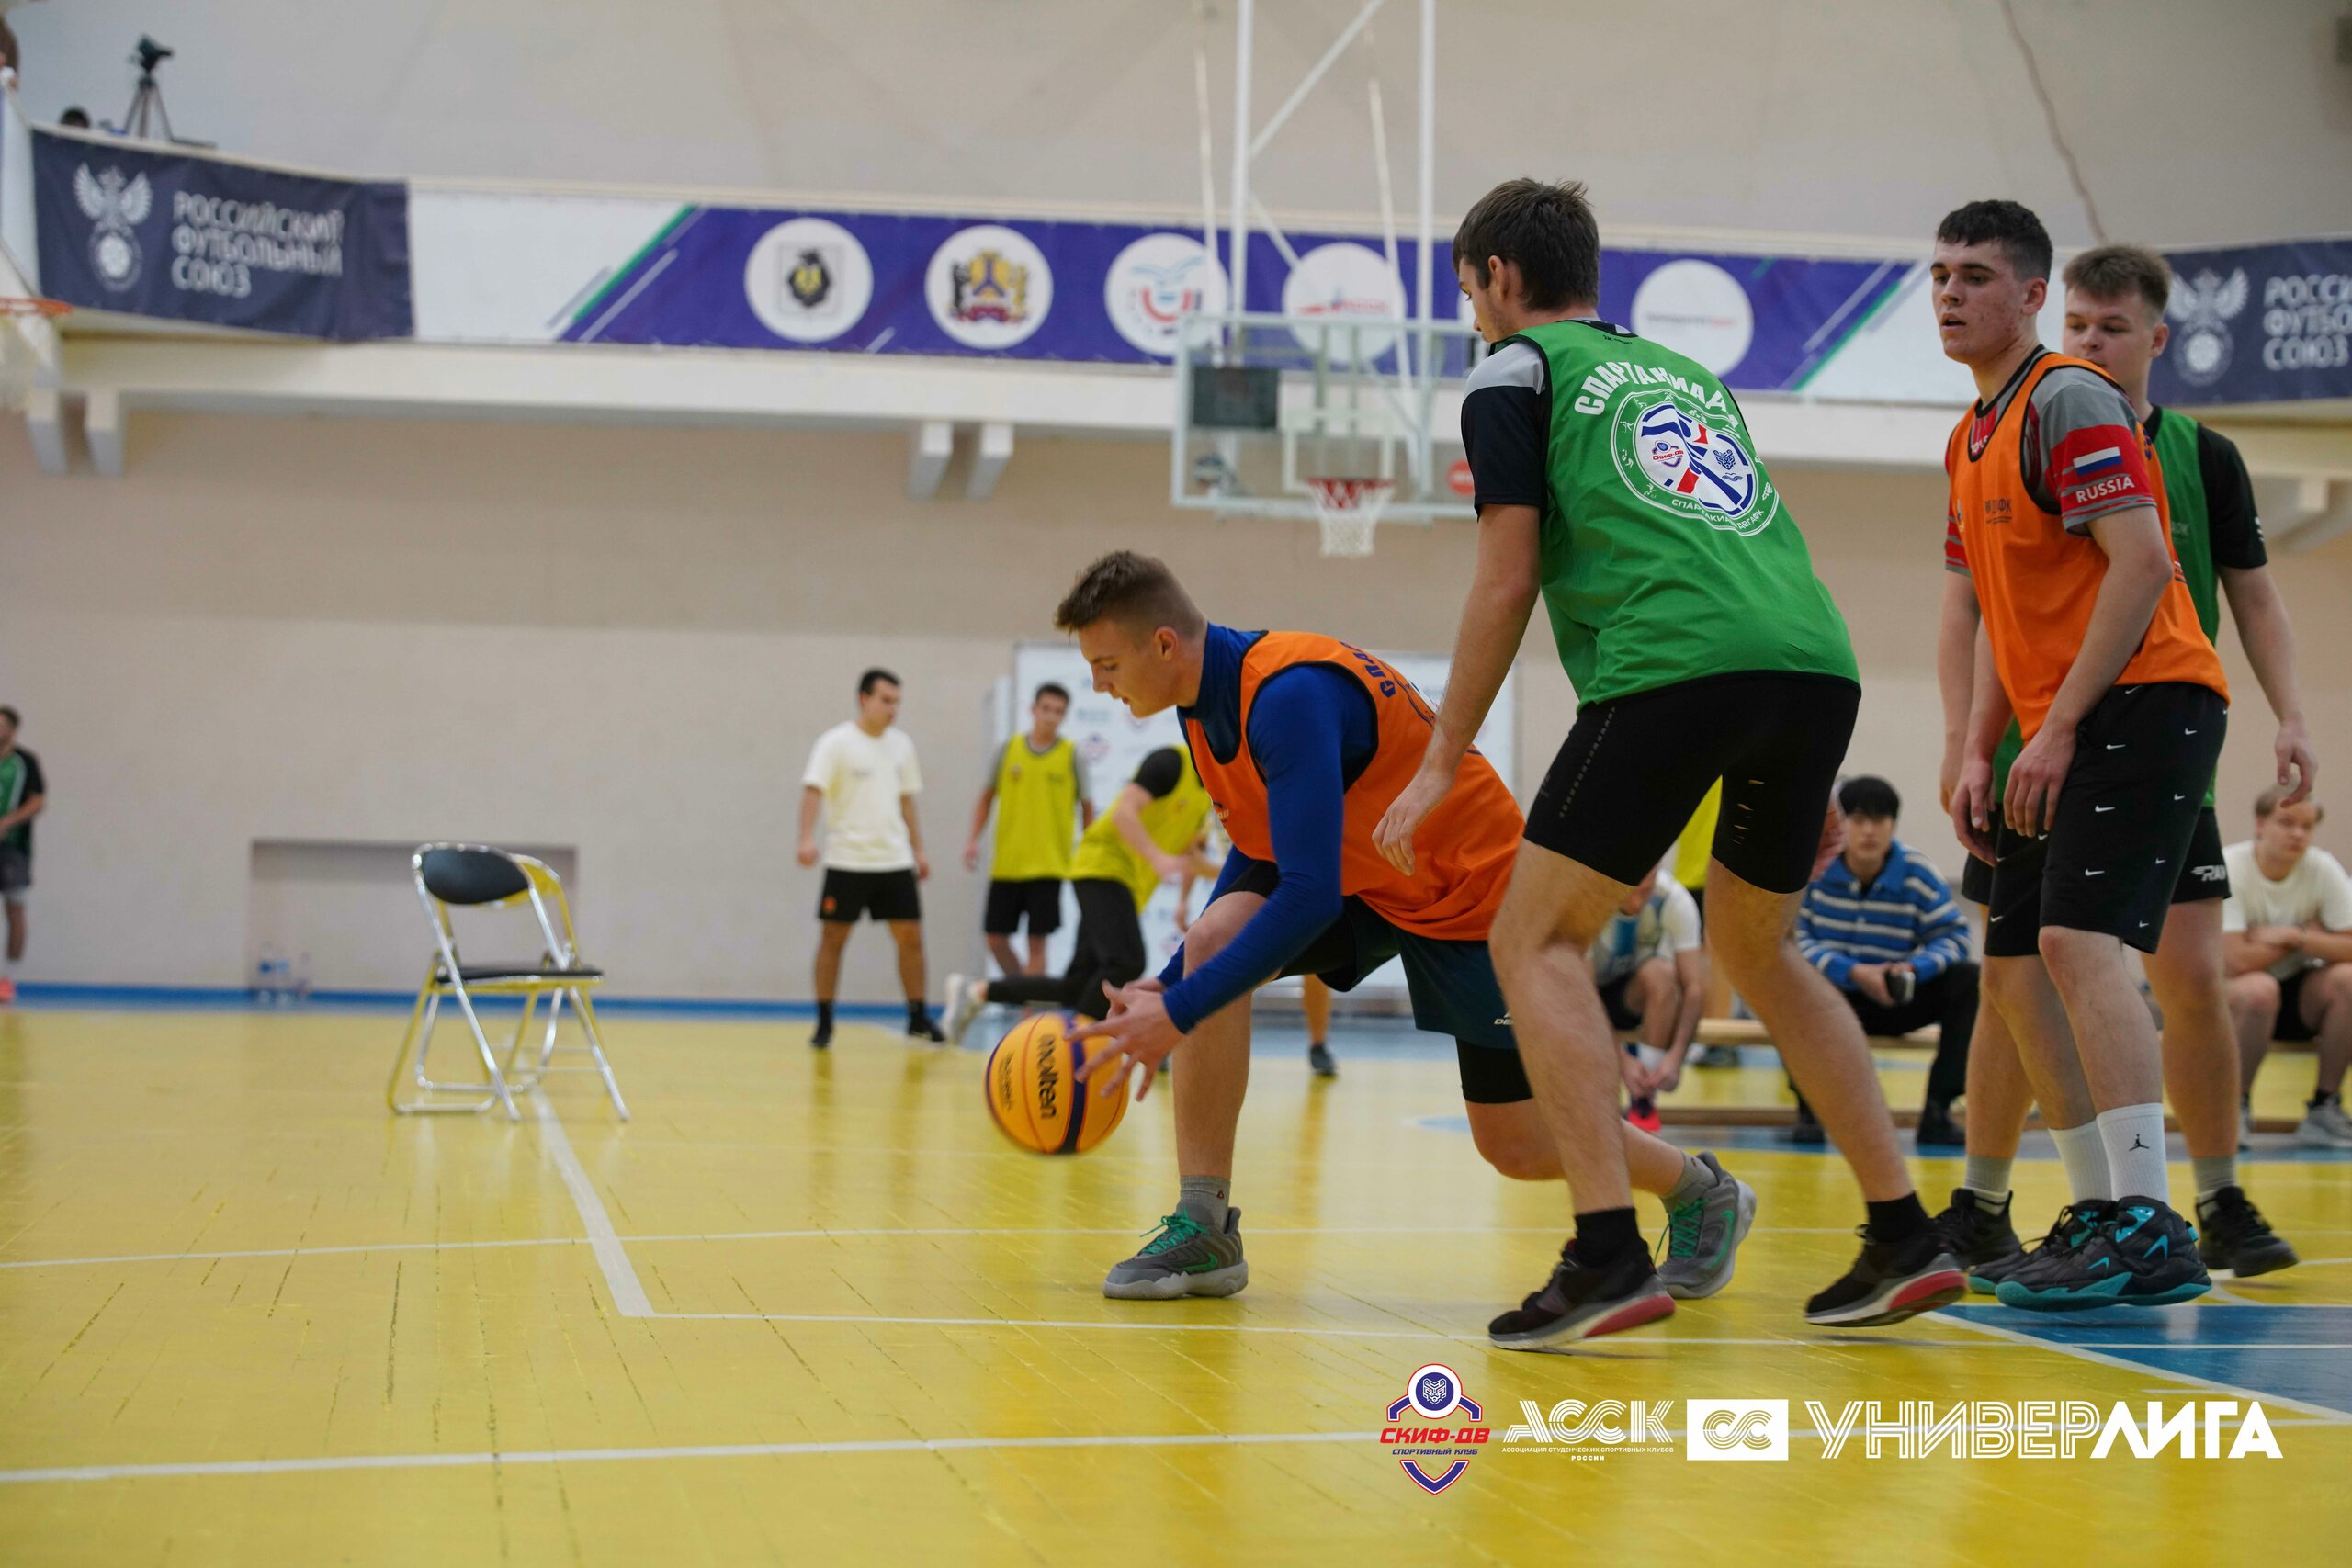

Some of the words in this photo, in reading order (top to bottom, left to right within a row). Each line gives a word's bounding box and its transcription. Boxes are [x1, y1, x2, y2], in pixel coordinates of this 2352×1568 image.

[173, 190, 345, 244] РОССИЙСКИЙ
[172, 224, 343, 276] ФУТБОЛЬНЫЙ
[172, 255, 252, 298] СОЮЗ
[2263, 334, 2349, 371] СОЮЗ
[2075, 476, 2135, 503] RUSSIA
[1036, 1033, 1059, 1121] molten
